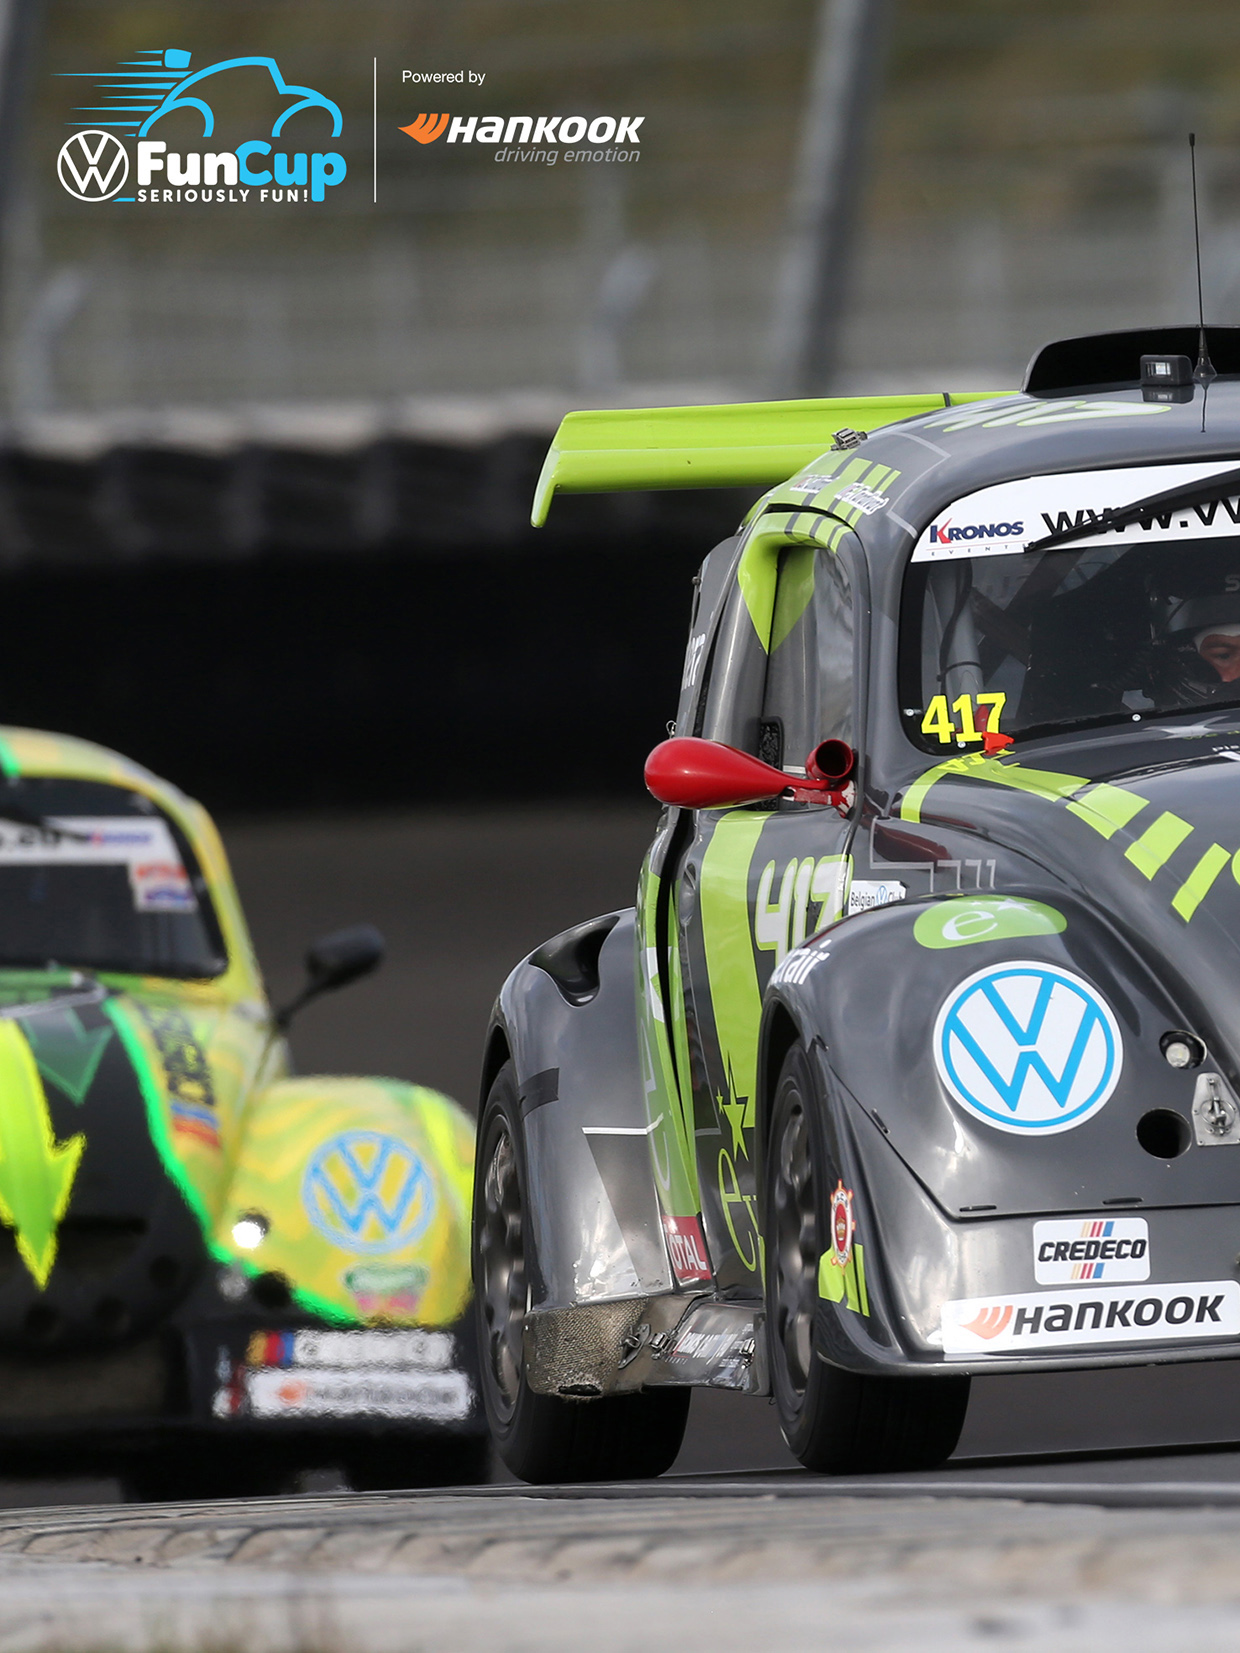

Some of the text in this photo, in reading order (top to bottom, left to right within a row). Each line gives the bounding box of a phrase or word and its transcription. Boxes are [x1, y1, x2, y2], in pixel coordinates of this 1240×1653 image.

[929, 517, 1024, 544] KRONOS
[920, 692, 1007, 744] 417
[850, 891, 876, 911] Belgian
[1037, 1238, 1147, 1262] CREDECO
